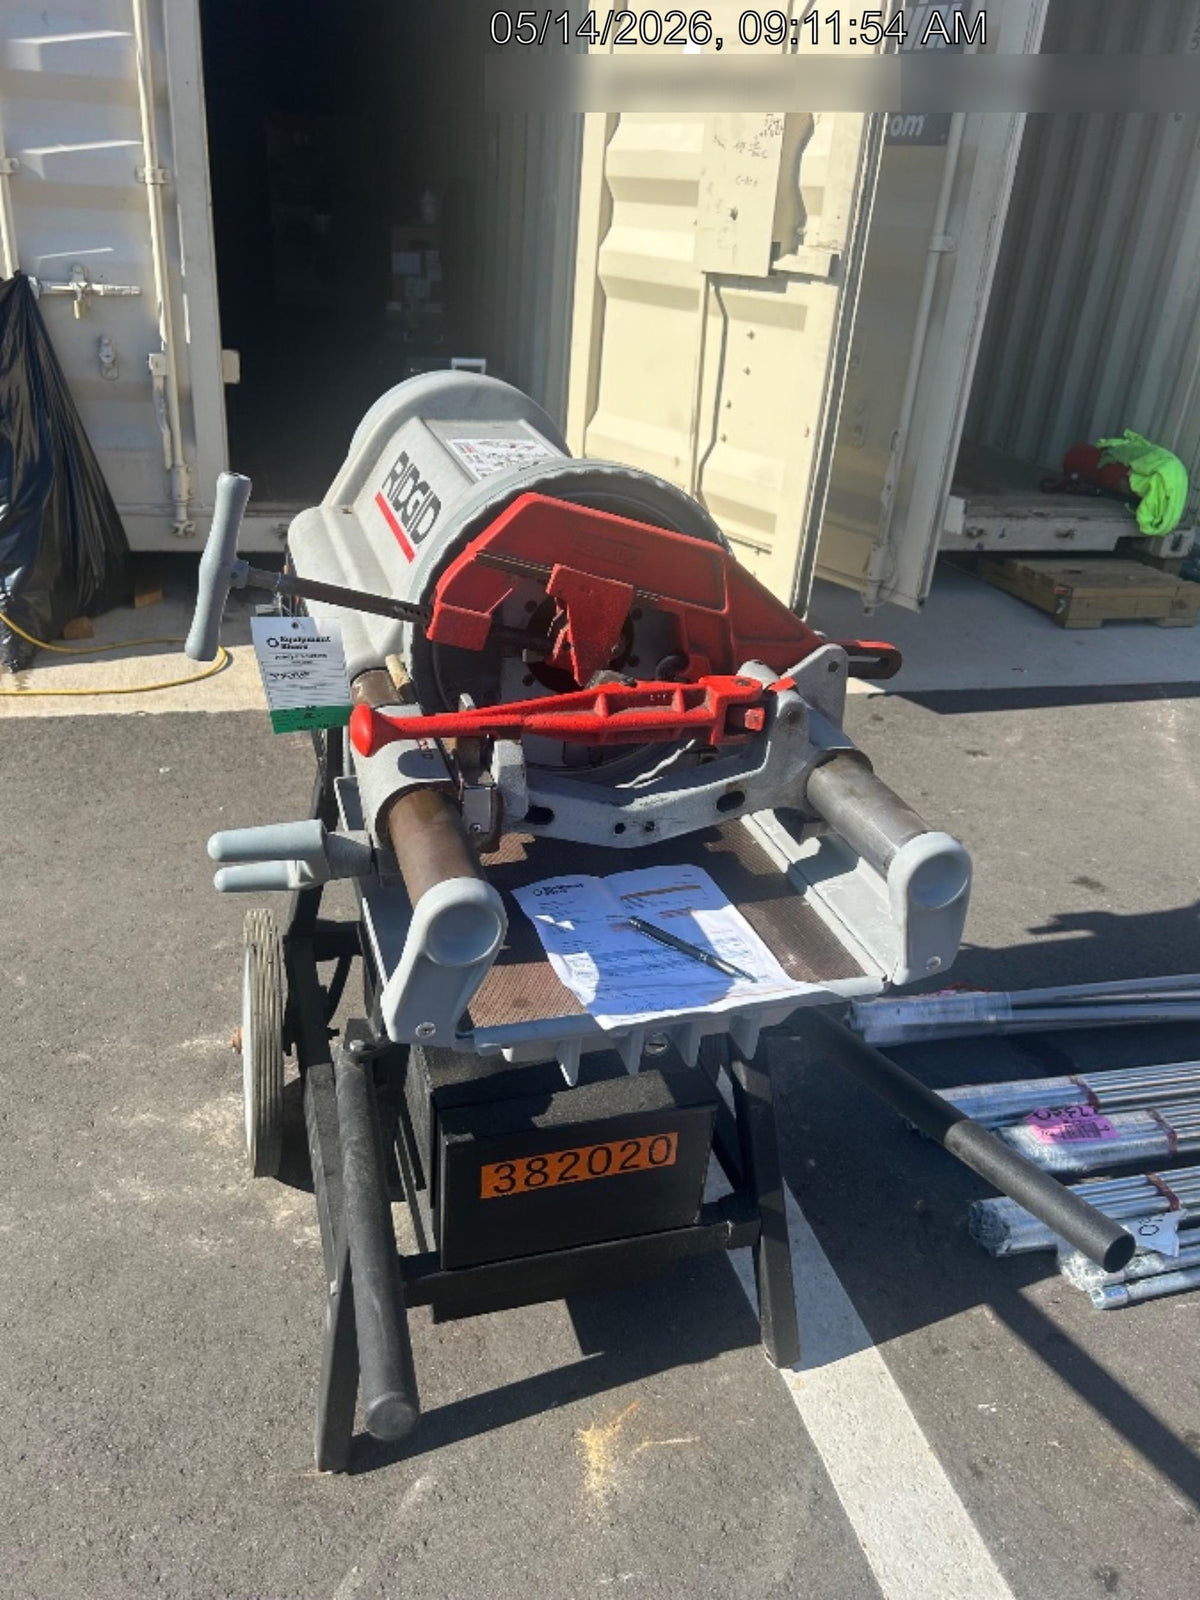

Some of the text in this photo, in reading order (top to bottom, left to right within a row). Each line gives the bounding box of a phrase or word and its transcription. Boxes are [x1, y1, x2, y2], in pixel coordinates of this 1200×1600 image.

[888, 114, 926, 137] om
[381, 450, 442, 545] RIDGID
[493, 1135, 673, 1194] 382020
